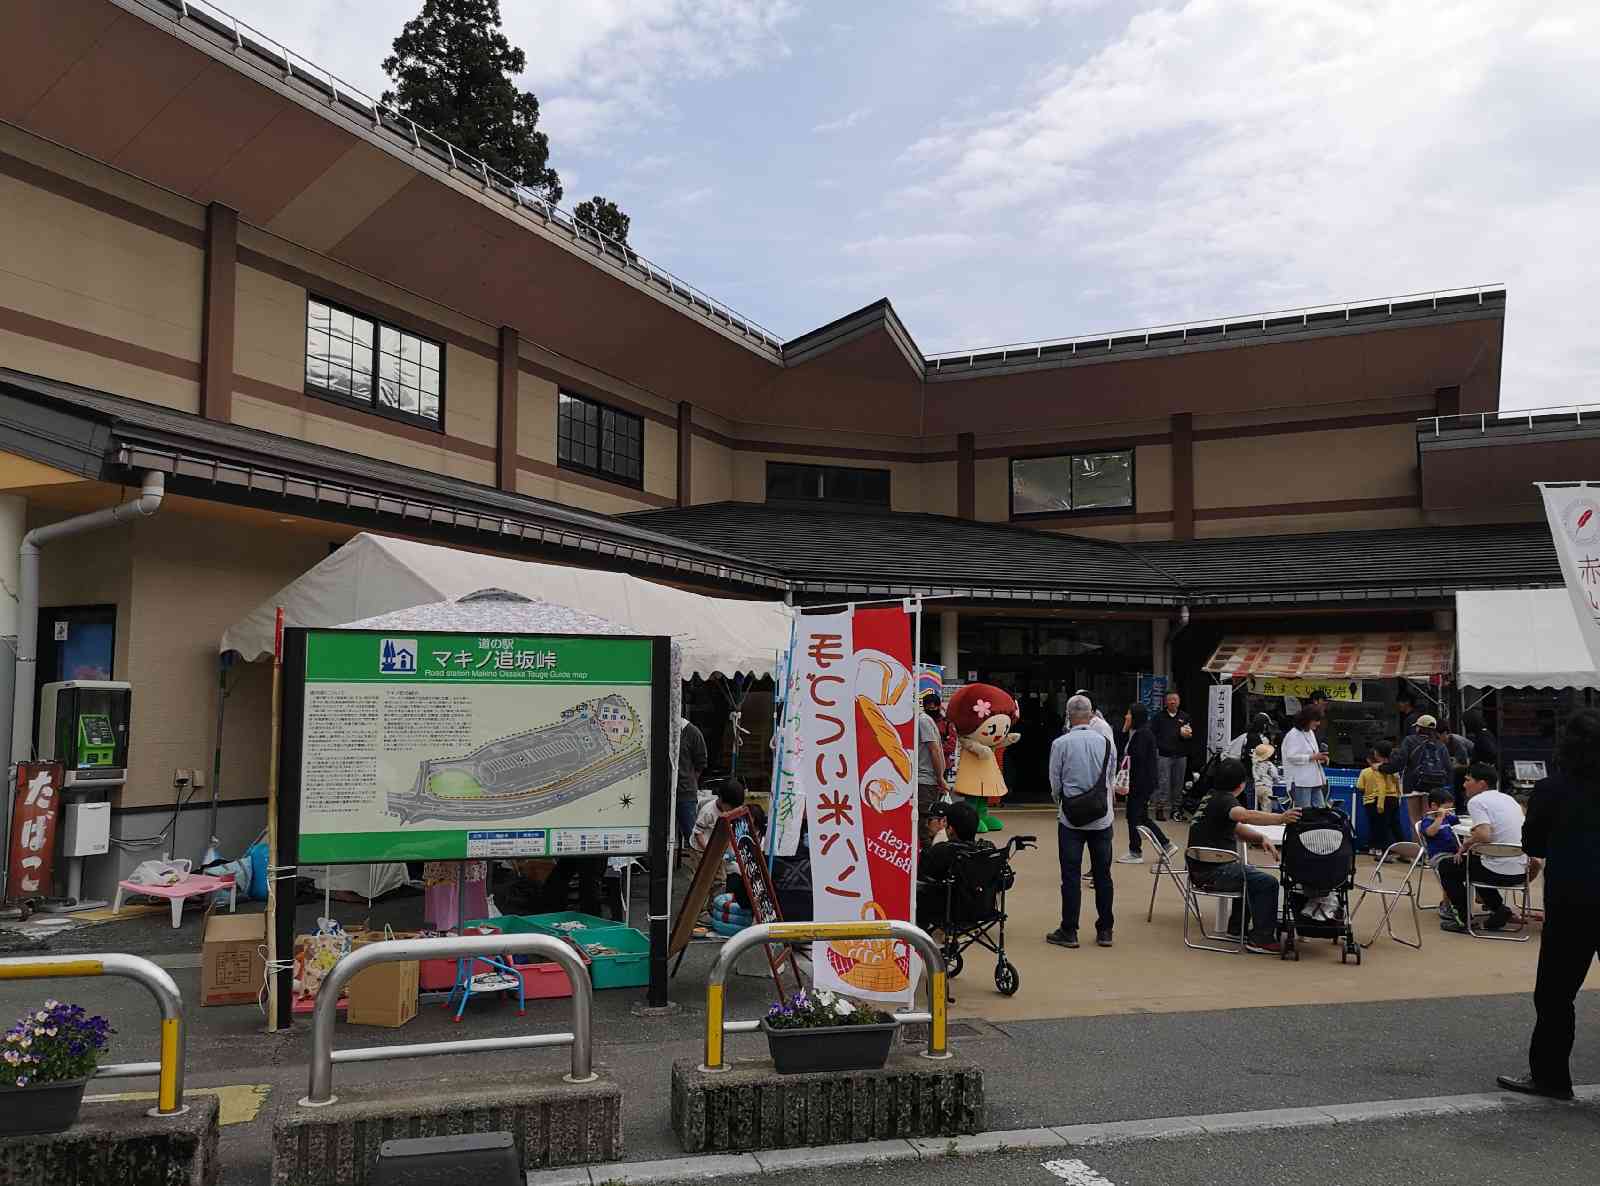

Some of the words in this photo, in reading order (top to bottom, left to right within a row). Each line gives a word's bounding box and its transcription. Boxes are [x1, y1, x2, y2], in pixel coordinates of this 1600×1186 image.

[478, 638, 514, 649] 道の駅
[431, 649, 558, 669] マキノ追坂峠
[550, 671, 571, 679] Guide
[573, 672, 588, 681] map
[20, 770, 55, 891] たばこ
